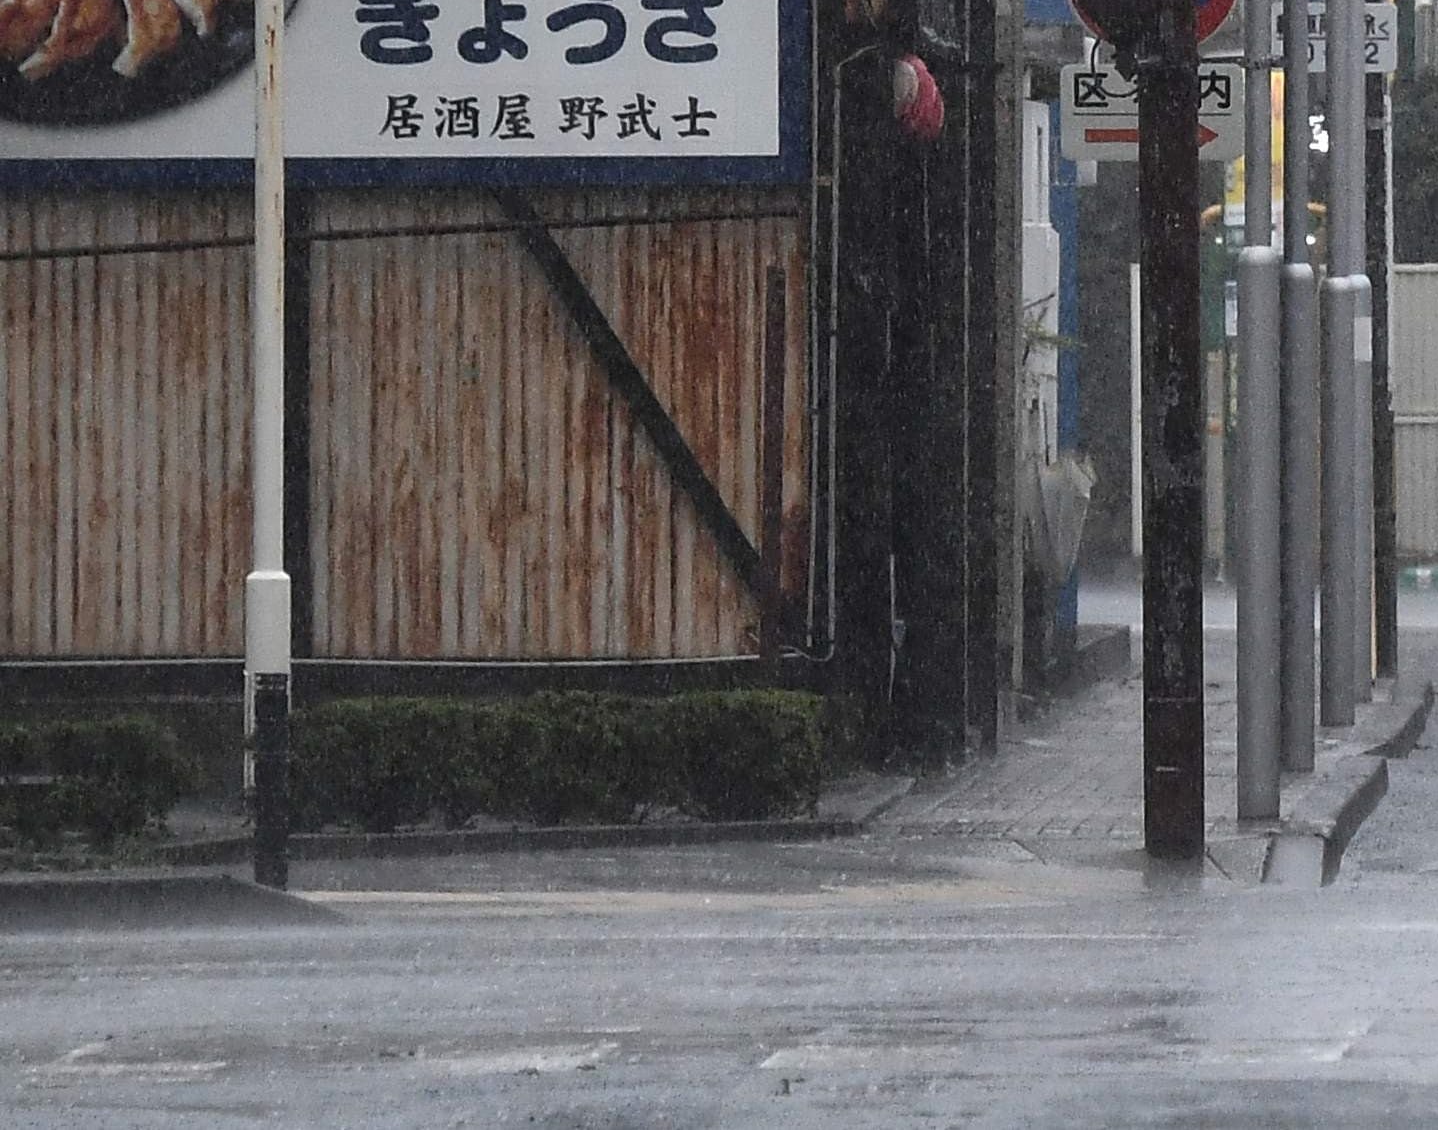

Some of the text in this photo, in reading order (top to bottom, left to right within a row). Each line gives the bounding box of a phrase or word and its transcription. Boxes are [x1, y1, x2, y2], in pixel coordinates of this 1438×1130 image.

[1073, 69, 1231, 110] 区内
[379, 93, 720, 142] 居酒屋 野武士
